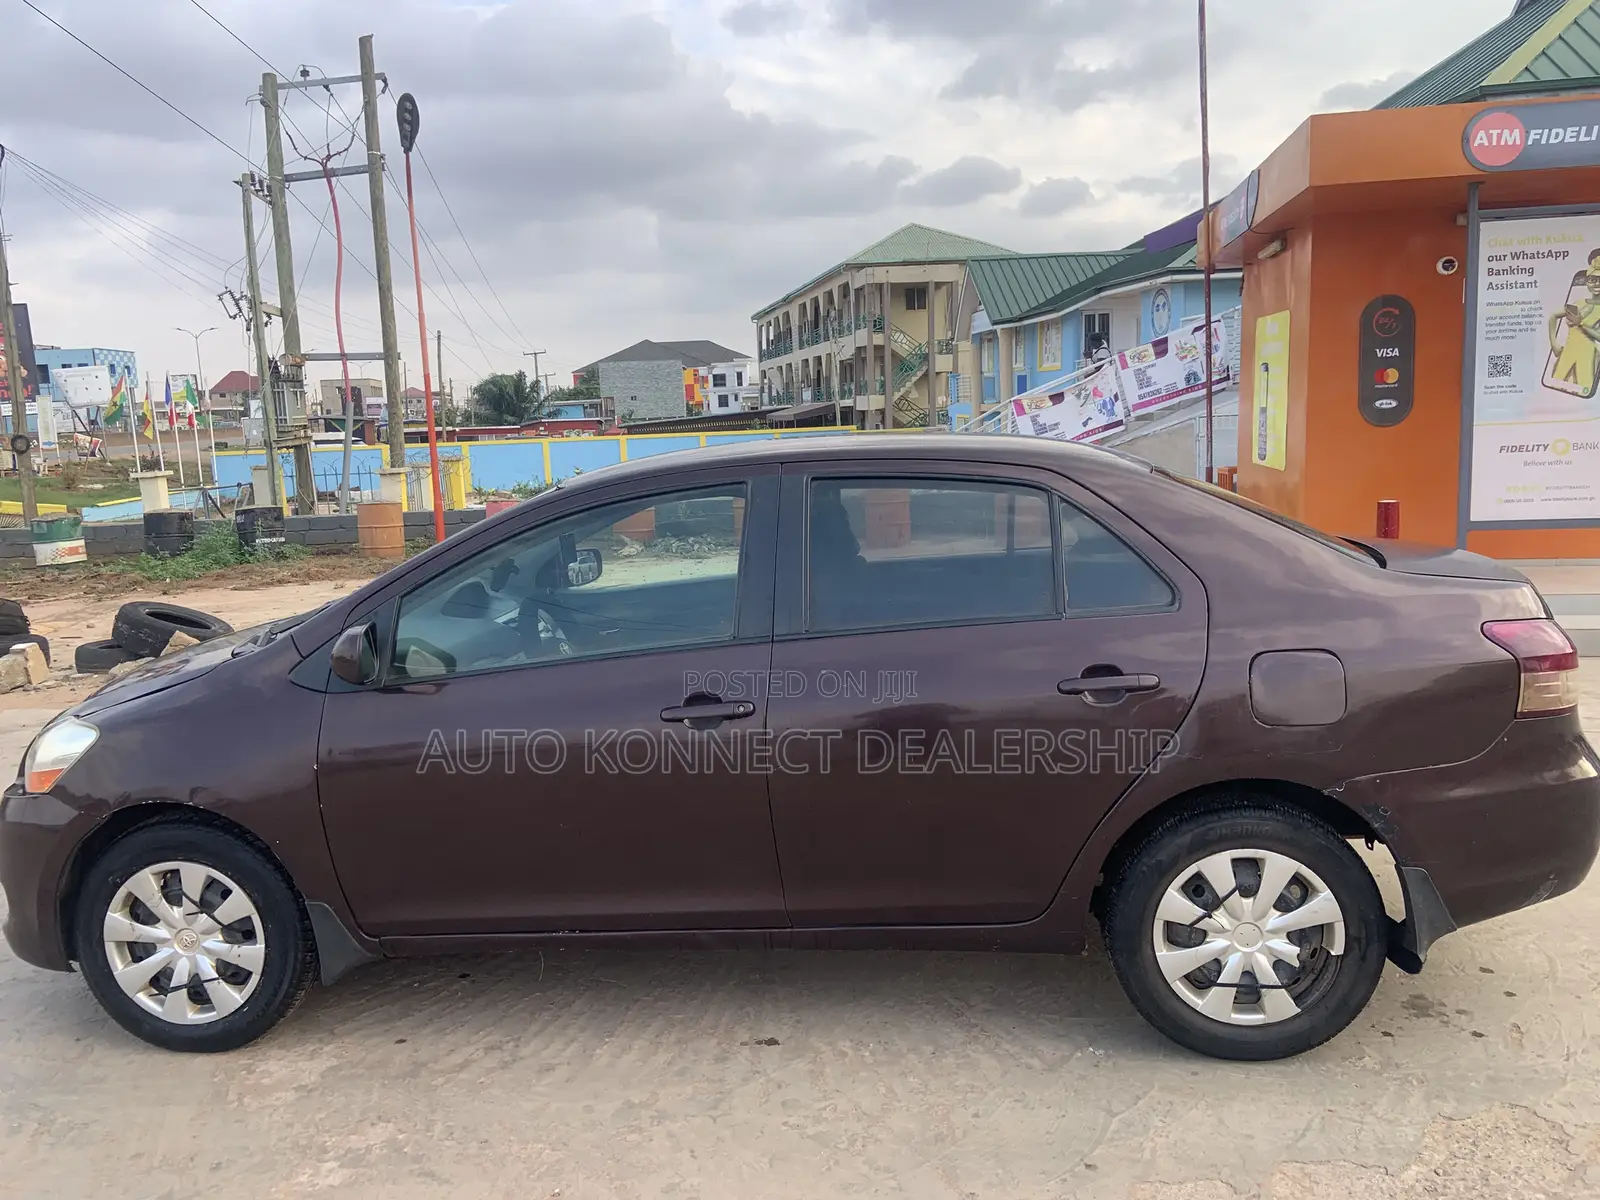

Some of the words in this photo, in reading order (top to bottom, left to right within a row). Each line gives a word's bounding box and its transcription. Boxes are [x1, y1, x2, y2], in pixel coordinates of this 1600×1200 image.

[1474, 129, 1520, 146] ATM
[1487, 254, 1508, 262] our
[1510, 249, 1570, 261] WhatsApp
[1487, 265, 1535, 277] Banking
[1486, 280, 1538, 291] Assistant
[1375, 347, 1399, 358] VISA
[1499, 443, 1549, 454] FIDELITY
[1572, 441, 1599, 451] BANK
